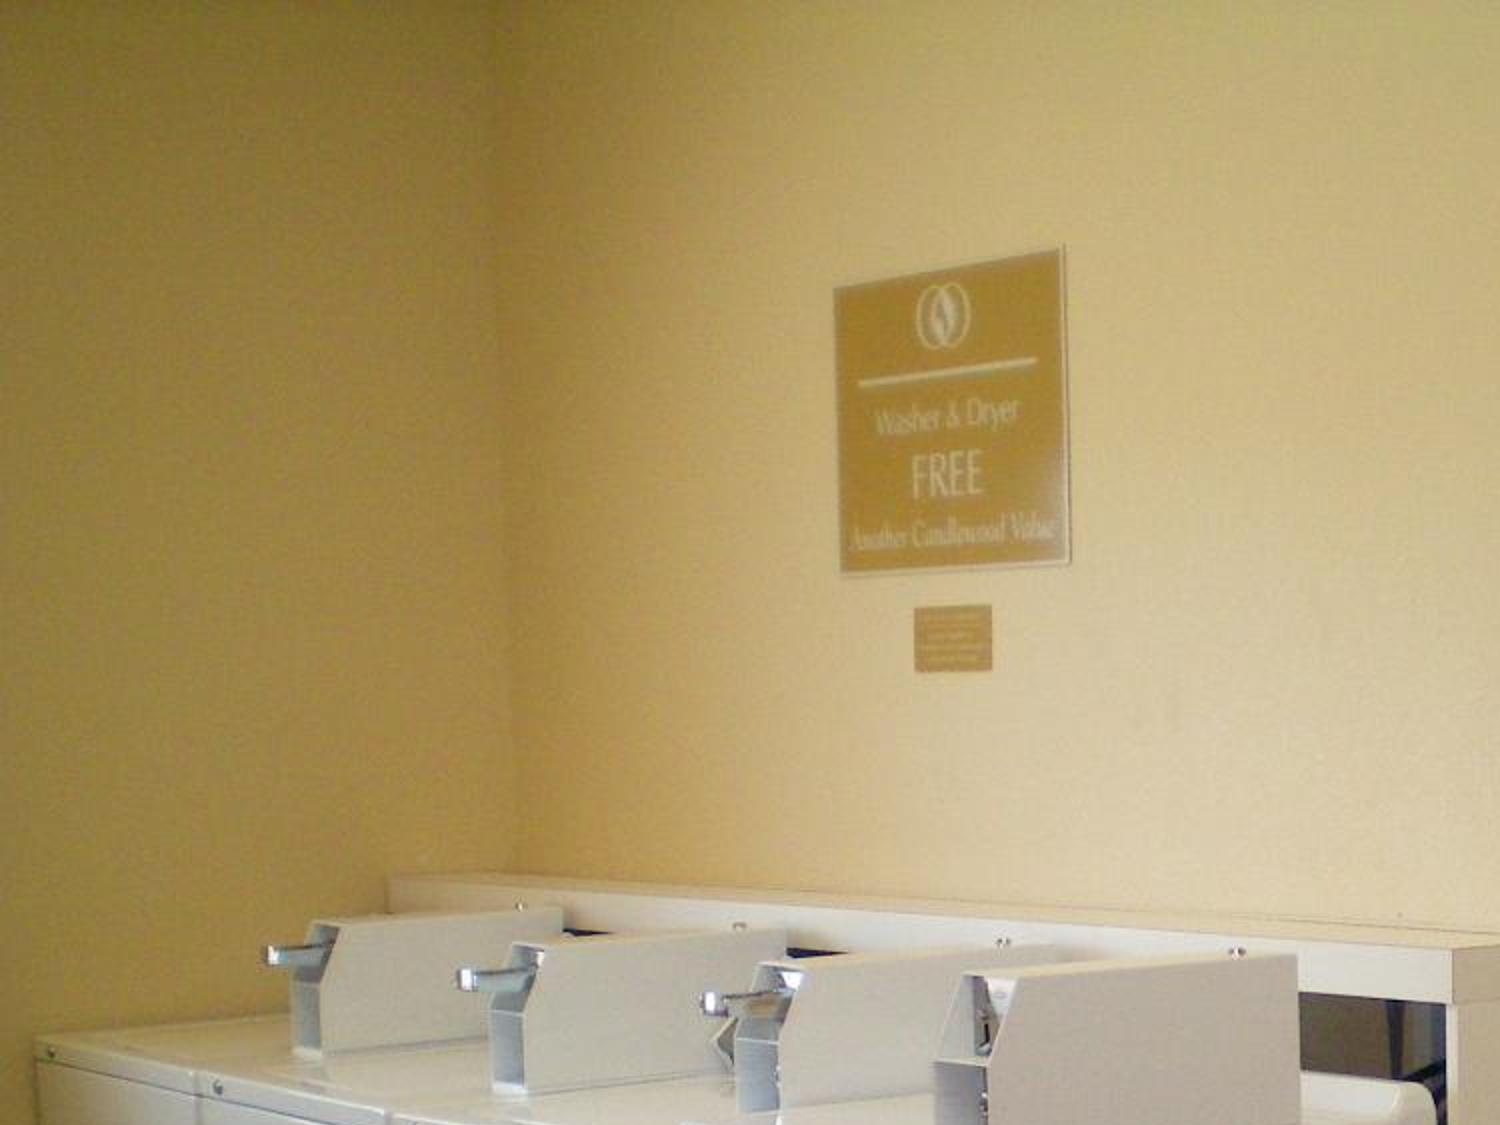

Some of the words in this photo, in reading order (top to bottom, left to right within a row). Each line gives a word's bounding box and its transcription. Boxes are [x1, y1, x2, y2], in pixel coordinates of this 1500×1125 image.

[875, 404, 940, 435] Washer
[947, 401, 960, 429] &
[967, 397, 1018, 432] Dryer
[912, 448, 985, 500] FREE
